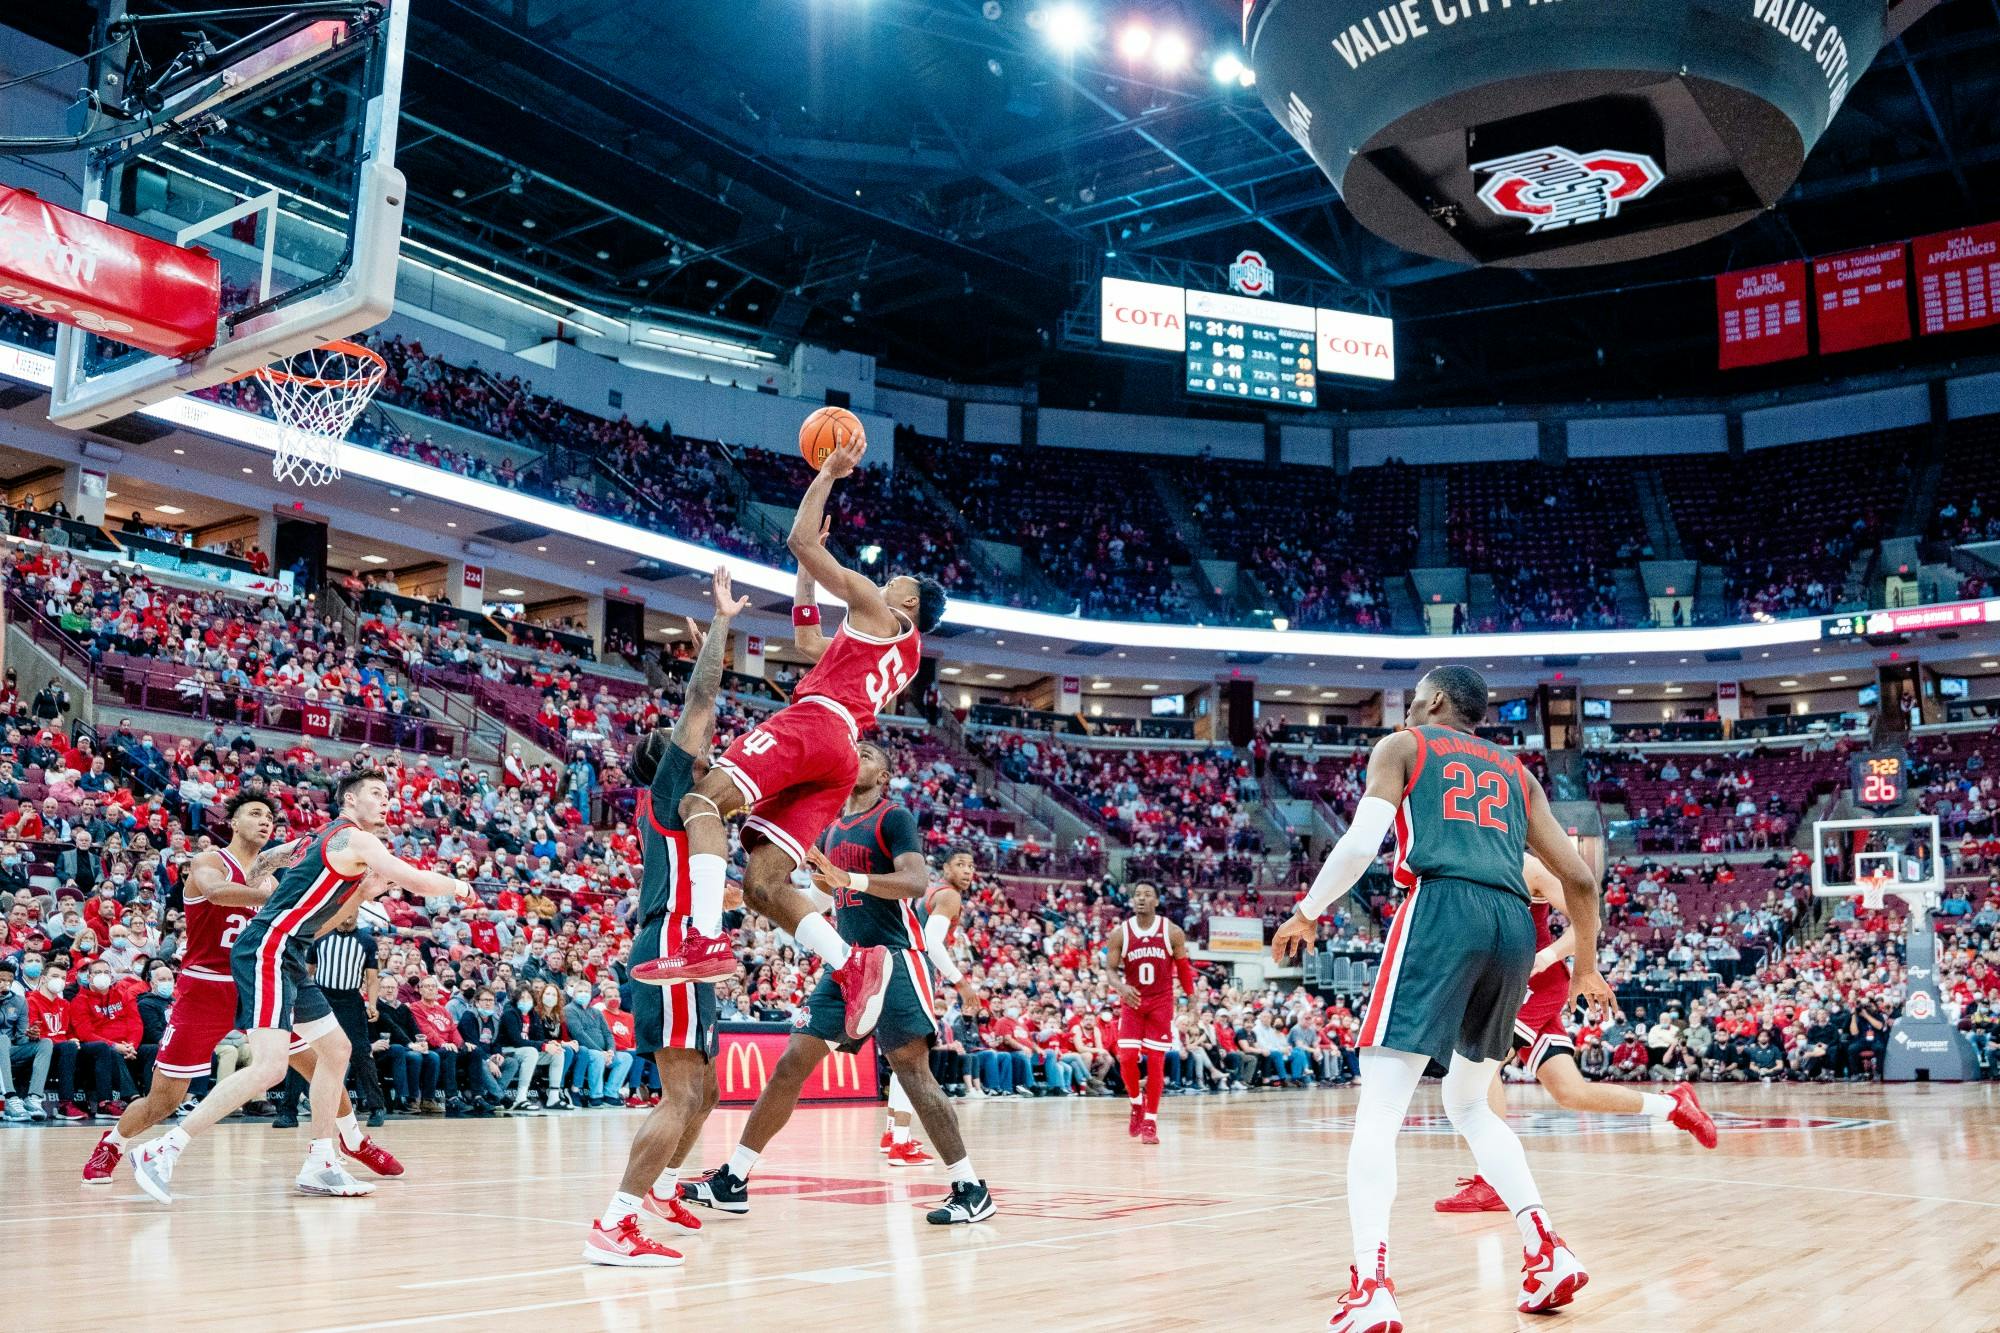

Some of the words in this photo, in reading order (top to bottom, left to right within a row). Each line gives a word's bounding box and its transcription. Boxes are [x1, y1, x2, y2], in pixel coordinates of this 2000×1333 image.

[1332, 0, 1428, 69] VALUE
[1433, 0, 1511, 26] CI
[1815, 25, 1849, 89] CITY
[1928, 241, 1997, 264] APPEARANCES
[1948, 235, 1974, 250] NCAA
[1816, 262, 1830, 274] BIG
[1832, 258, 1848, 270] TEN
[1850, 249, 1901, 267] TOURNAMENT
[1743, 276, 1758, 288] BIG
[1761, 272, 1777, 285] TEN
[1837, 265, 1882, 282] CHAMPIONS
[1736, 281, 1785, 299] CHAMPIONS
[1115, 306, 1180, 330] COTA
[1299, 343, 1309, 355] 4
[1329, 337, 1389, 359] COTA
[465, 571, 481, 583] 224
[307, 713, 327, 728] 123
[1868, 758, 1899, 775] 7:22
[1443, 761, 1509, 834] 22
[1865, 775, 1896, 801] 26
[221, 913, 252, 949] 2
[1128, 946, 1166, 962] INDIANA
[1138, 962, 1155, 985] 0
